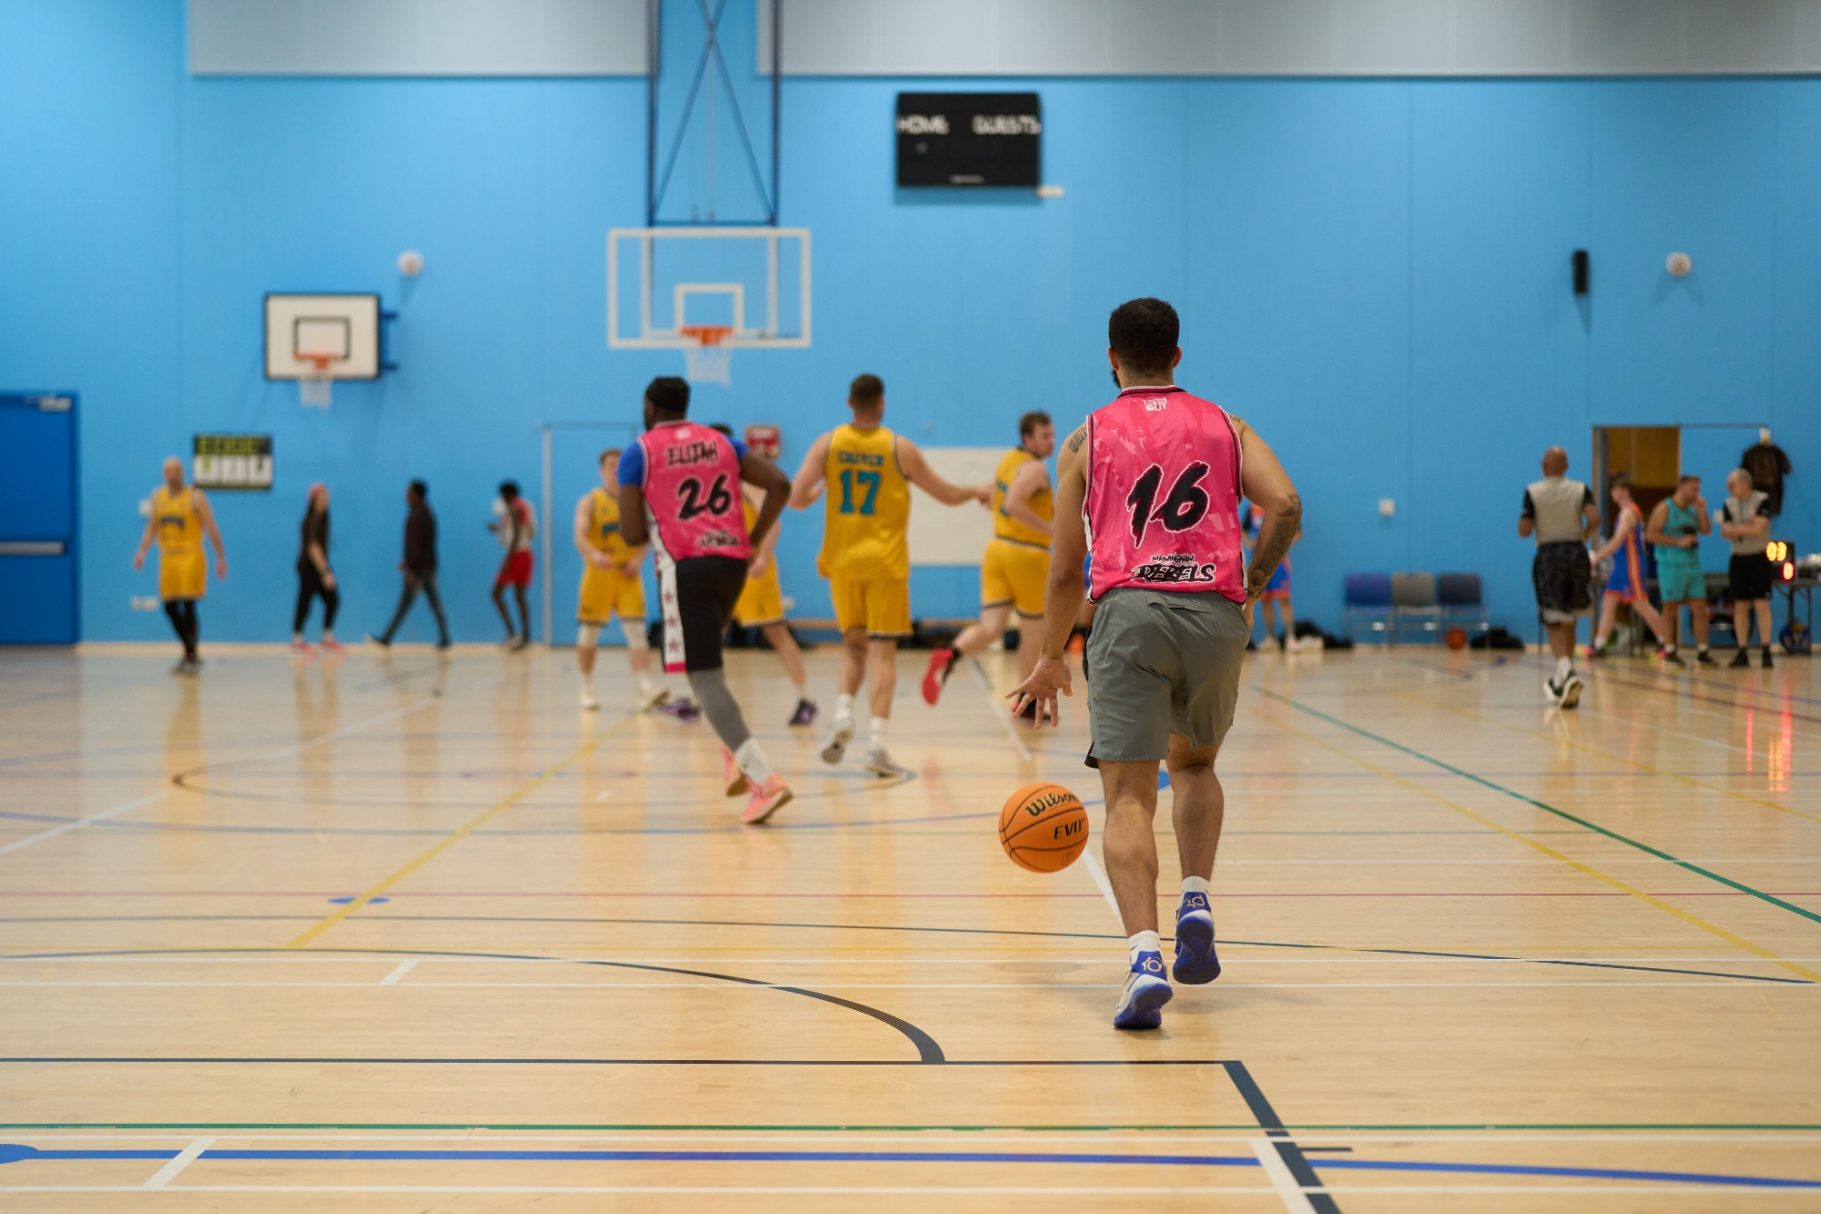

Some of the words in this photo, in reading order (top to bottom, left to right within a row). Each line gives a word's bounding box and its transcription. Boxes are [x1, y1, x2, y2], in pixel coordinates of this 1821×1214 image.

[897, 114, 949, 135] HOME
[972, 114, 1041, 135] GUESTS
[678, 473, 732, 520] 26
[839, 469, 882, 515] 17
[1126, 460, 1210, 549] 16
[1025, 792, 1079, 817] Wilson
